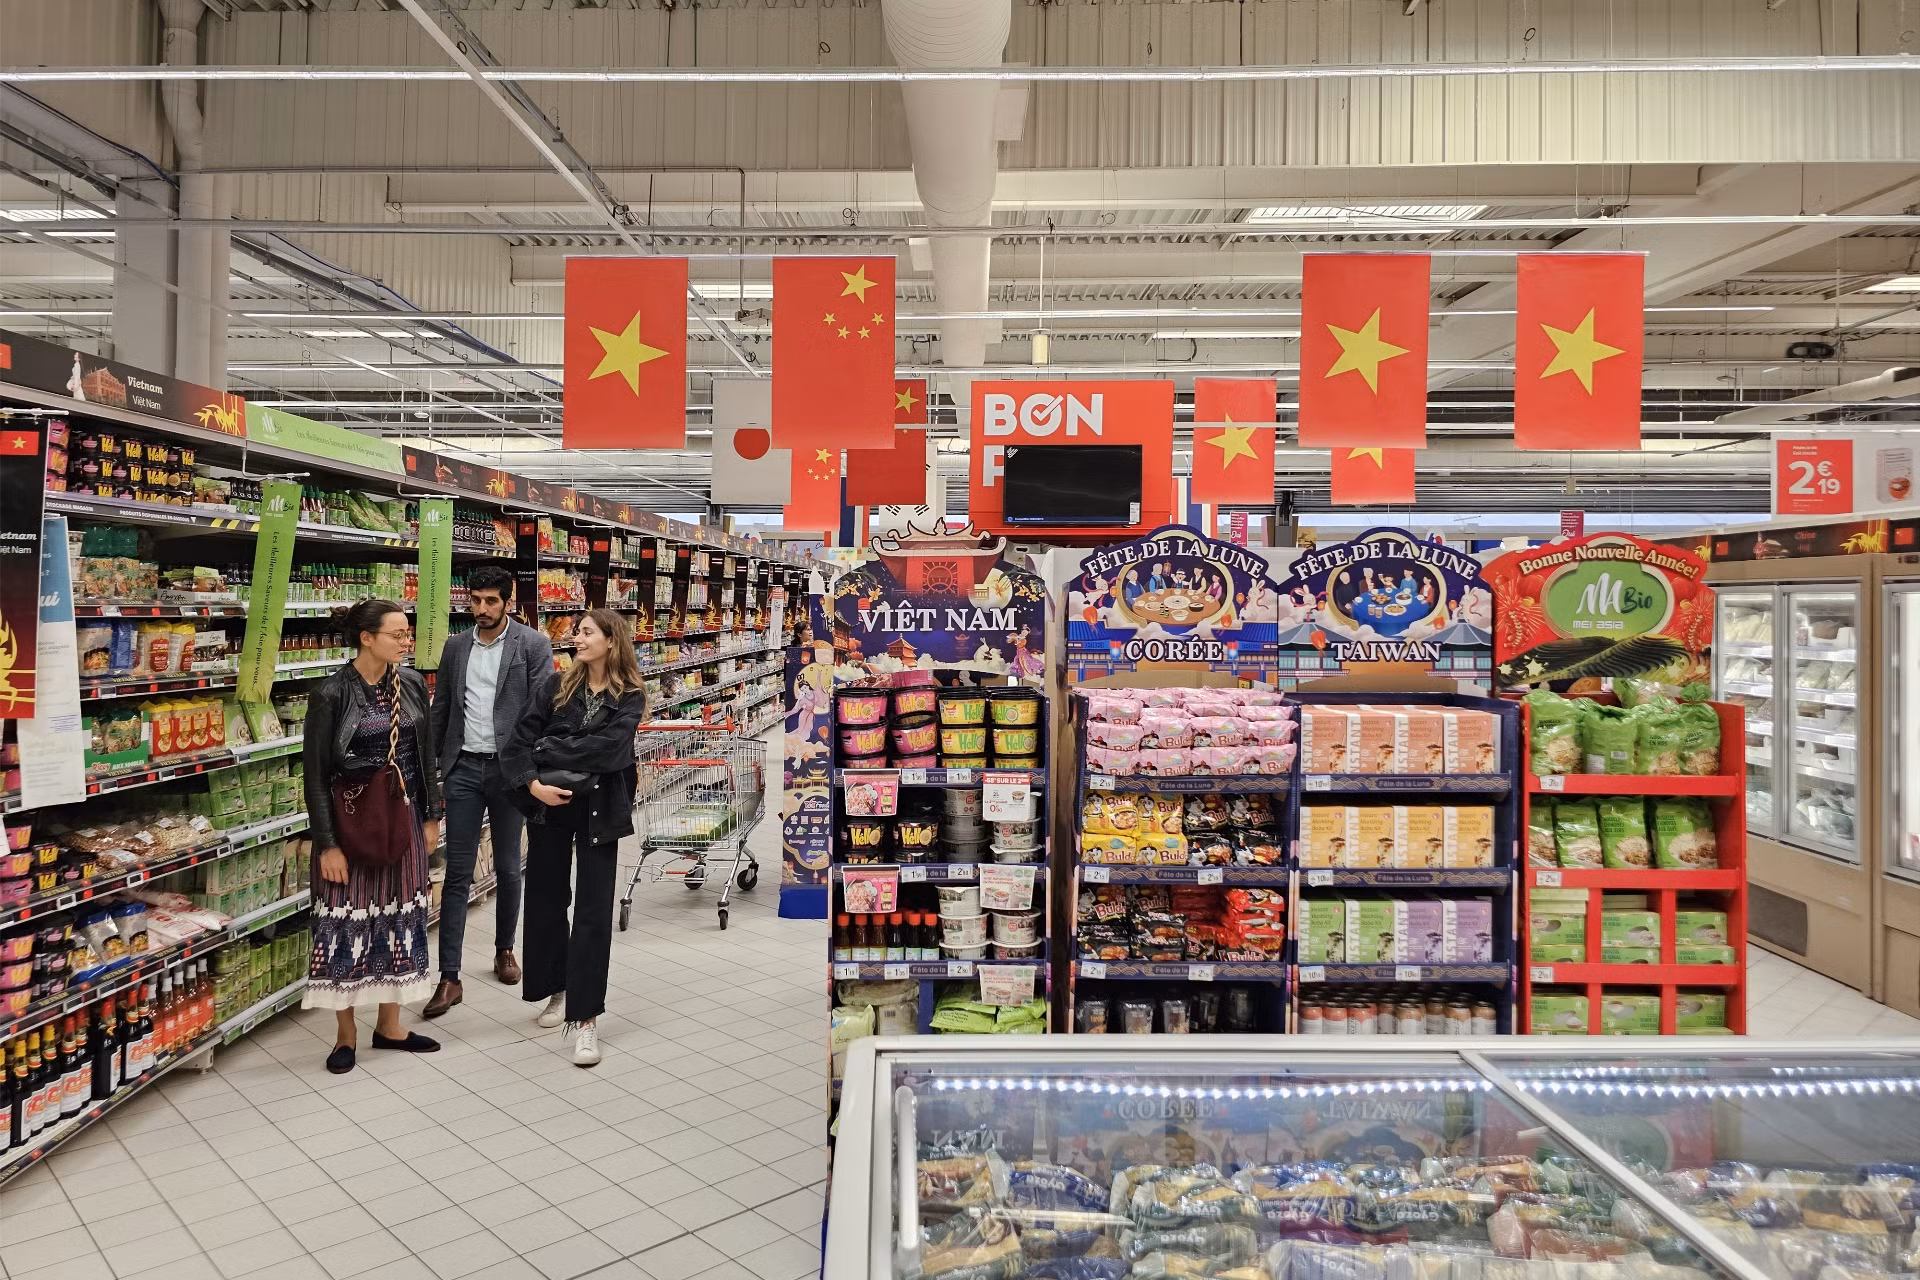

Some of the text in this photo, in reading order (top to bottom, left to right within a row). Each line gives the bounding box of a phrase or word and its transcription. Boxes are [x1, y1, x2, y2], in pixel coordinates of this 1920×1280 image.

[127, 375, 164, 395] Vietnam
[145, 398, 161, 411] Nam
[982, 393, 1104, 436] BON
[46, 501, 94, 512] STOCKAGE MAGASIN
[119, 509, 142, 517] PRODUITS
[12, 545, 32, 554] Nam
[1085, 538, 1264, 579] FÊTE DE LA LUNE
[1294, 541, 1477, 581] FÊTE DE LA LUNE
[1518, 545, 1699, 580] Bonne Nouvelle Année!
[40, 592, 60, 608] ui
[1621, 586, 1653, 614] Bio
[857, 599, 1018, 633] VIÊT NAM
[1125, 636, 1223, 661] CORÉE
[1331, 641, 1442, 662] TAIWAN
[1302, 720, 1312, 774] NSTANT
[1350, 720, 1360, 774] NSTANT
[1398, 720, 1408, 774] NSTANT
[1378, 874, 1429, 882] Fête de la Lune
[1155, 966, 1188, 974] Fête de la
